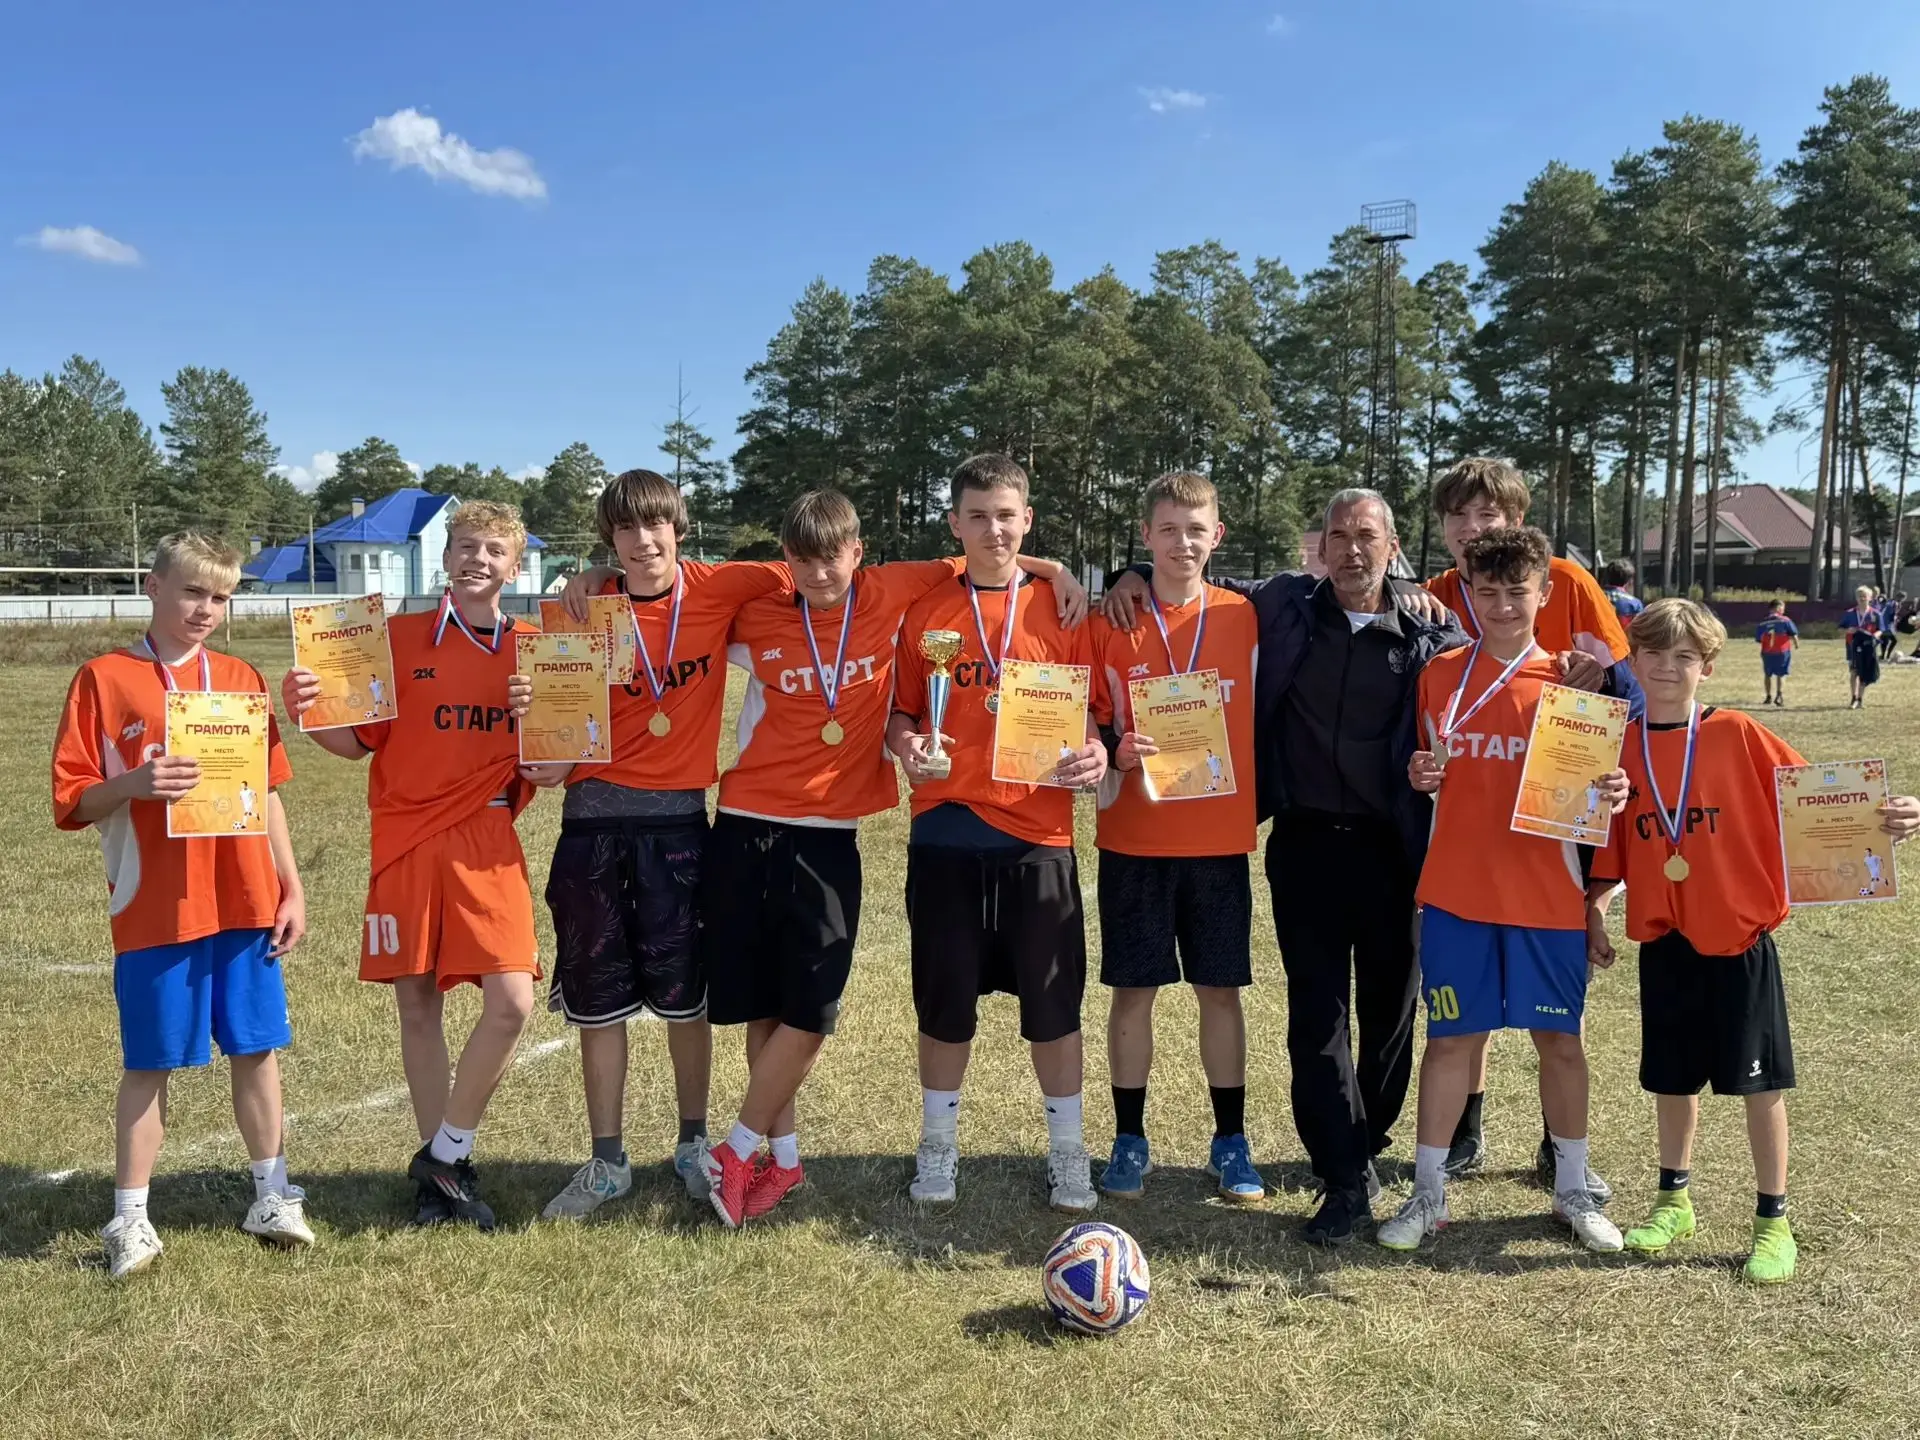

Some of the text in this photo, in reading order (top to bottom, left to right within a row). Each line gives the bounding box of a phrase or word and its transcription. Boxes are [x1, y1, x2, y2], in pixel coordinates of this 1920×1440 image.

[312, 624, 374, 642] ГРАМОТА
[761, 648, 782, 661] 2K
[413, 668, 436, 680] 2K
[534, 662, 593, 673] ГРАМОТА
[623, 653, 711, 696] САРТ
[1128, 662, 1150, 678] 2K
[1015, 688, 1072, 702] ГРАМОТА
[1149, 699, 1208, 716] ГРАМОТА
[186, 724, 250, 736] ГРАМОТА
[1549, 716, 1608, 738] ГРАМОТА
[1446, 733, 1528, 761] СТАР
[1570, 744, 1589, 752] МЕСТО
[1797, 792, 1870, 807] ГРАМОТА
[366, 914, 400, 956] 10
[1536, 1004, 1568, 1015] KELME
